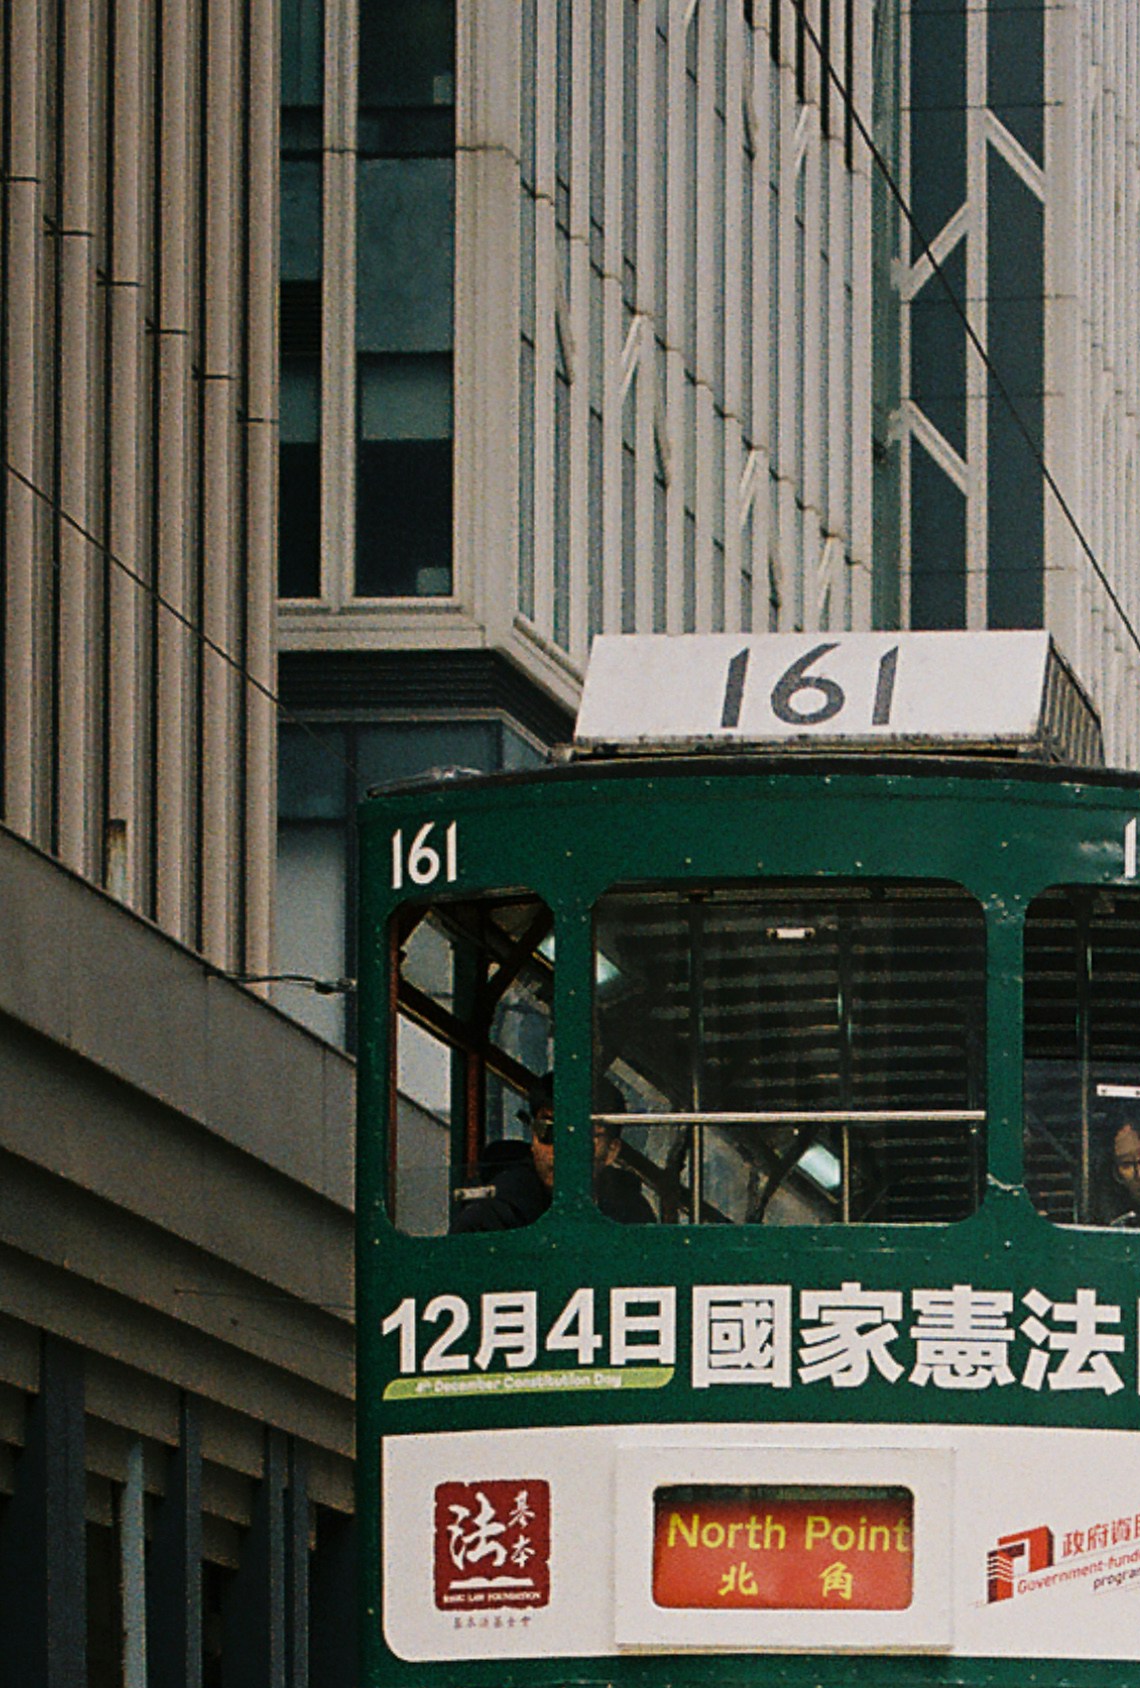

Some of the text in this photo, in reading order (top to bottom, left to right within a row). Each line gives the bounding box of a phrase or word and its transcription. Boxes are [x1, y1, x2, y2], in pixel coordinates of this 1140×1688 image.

[720, 643, 899, 729] 161
[391, 822, 458, 889] 161
[503, 1373, 591, 1389] Constitution
[593, 1372, 622, 1388] Day
[667, 1513, 911, 1552] North Point
[718, 1562, 854, 1600] 北角
